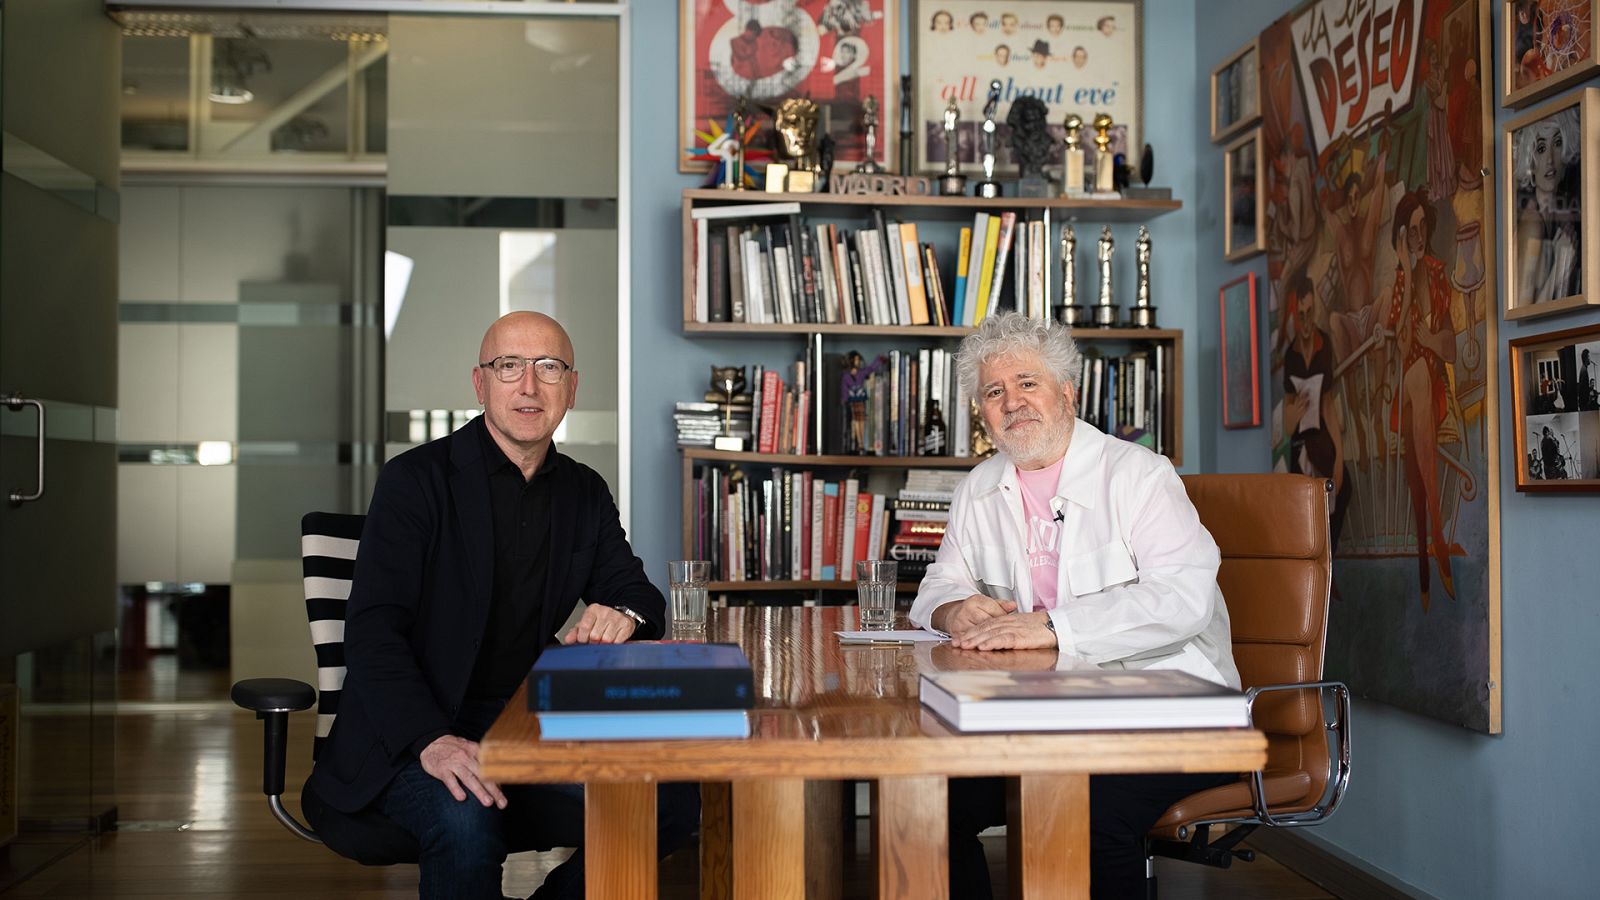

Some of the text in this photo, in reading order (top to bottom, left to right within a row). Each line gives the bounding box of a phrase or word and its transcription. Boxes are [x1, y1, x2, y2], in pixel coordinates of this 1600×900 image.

[1309, 0, 1415, 140] DESEO
[830, 173, 931, 196] MADRID
[734, 301, 743, 317] 5
[890, 544, 938, 561] Chris
